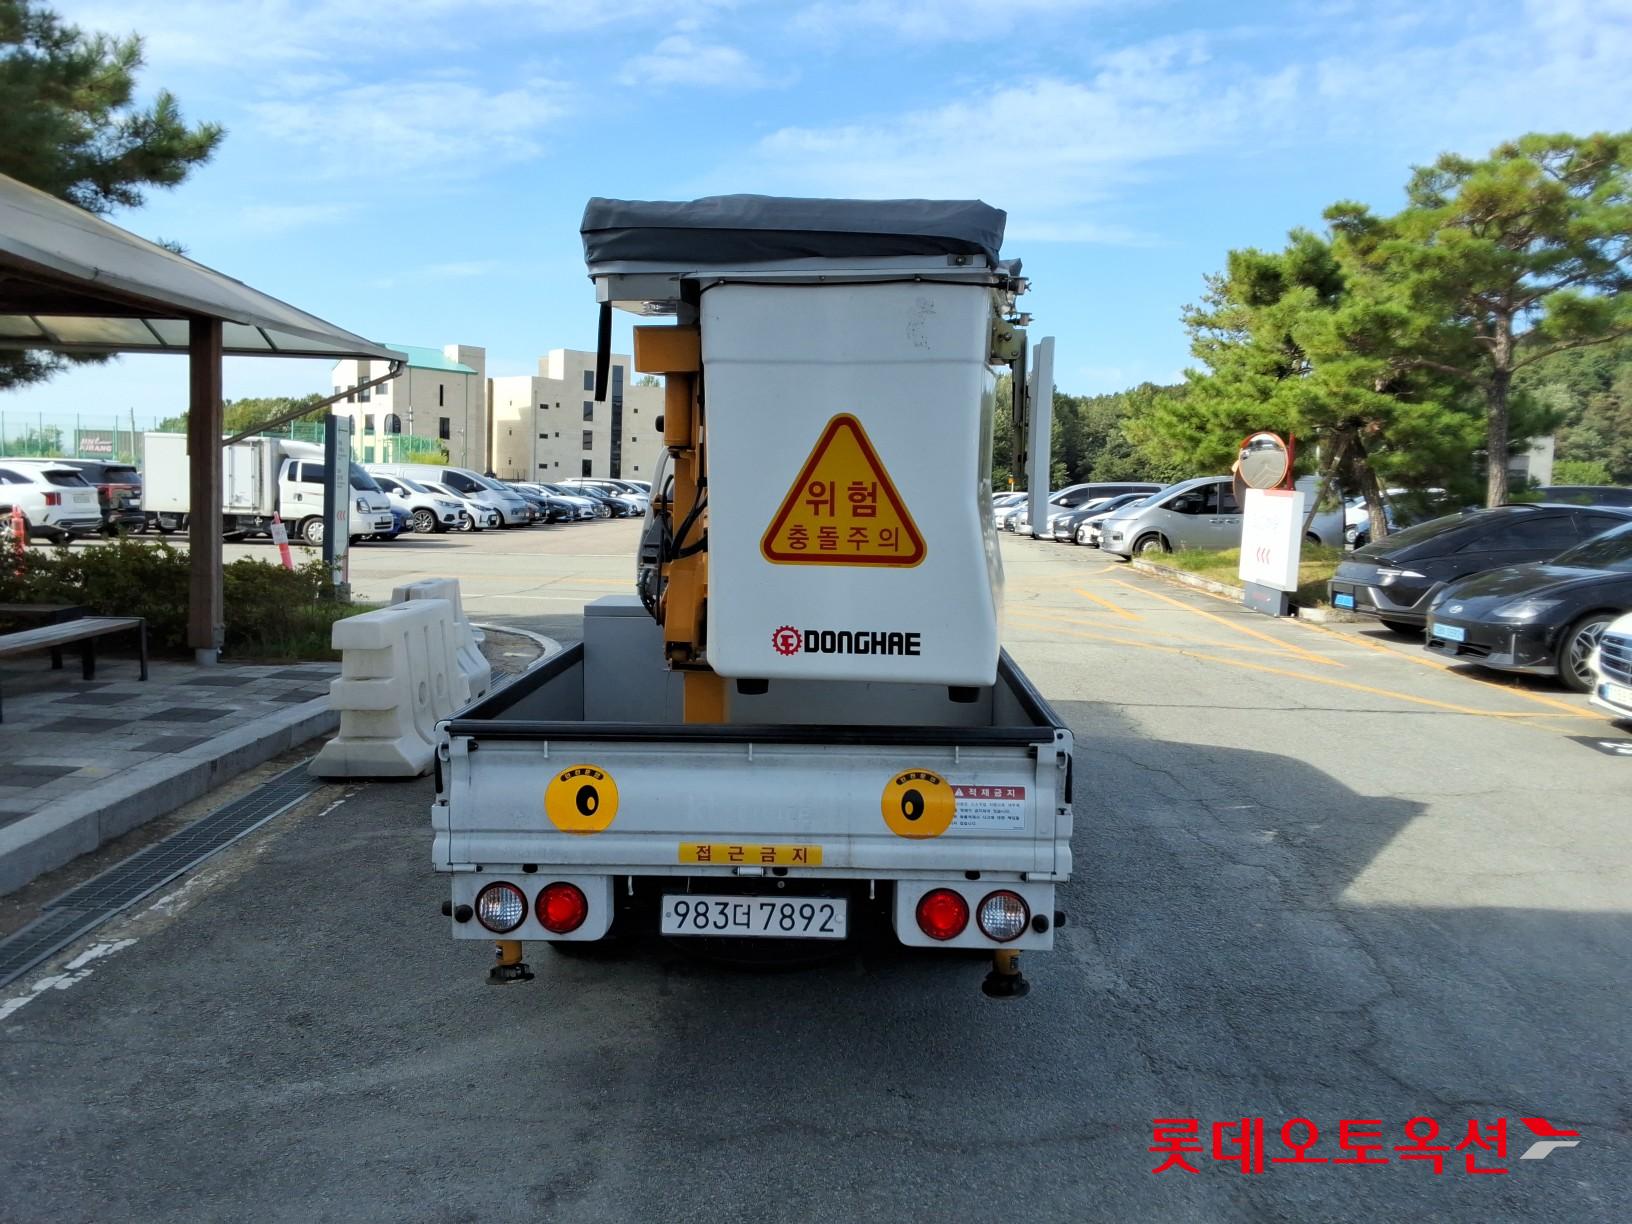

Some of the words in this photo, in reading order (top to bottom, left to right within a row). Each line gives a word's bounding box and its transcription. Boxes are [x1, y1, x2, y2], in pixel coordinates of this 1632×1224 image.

[805, 480, 878, 518] 위험
[786, 524, 900, 552] 충돌주의
[803, 630, 921, 656] DONGHAE
[968, 787, 1016, 798] 적재금지
[695, 844, 809, 863] 접근금지
